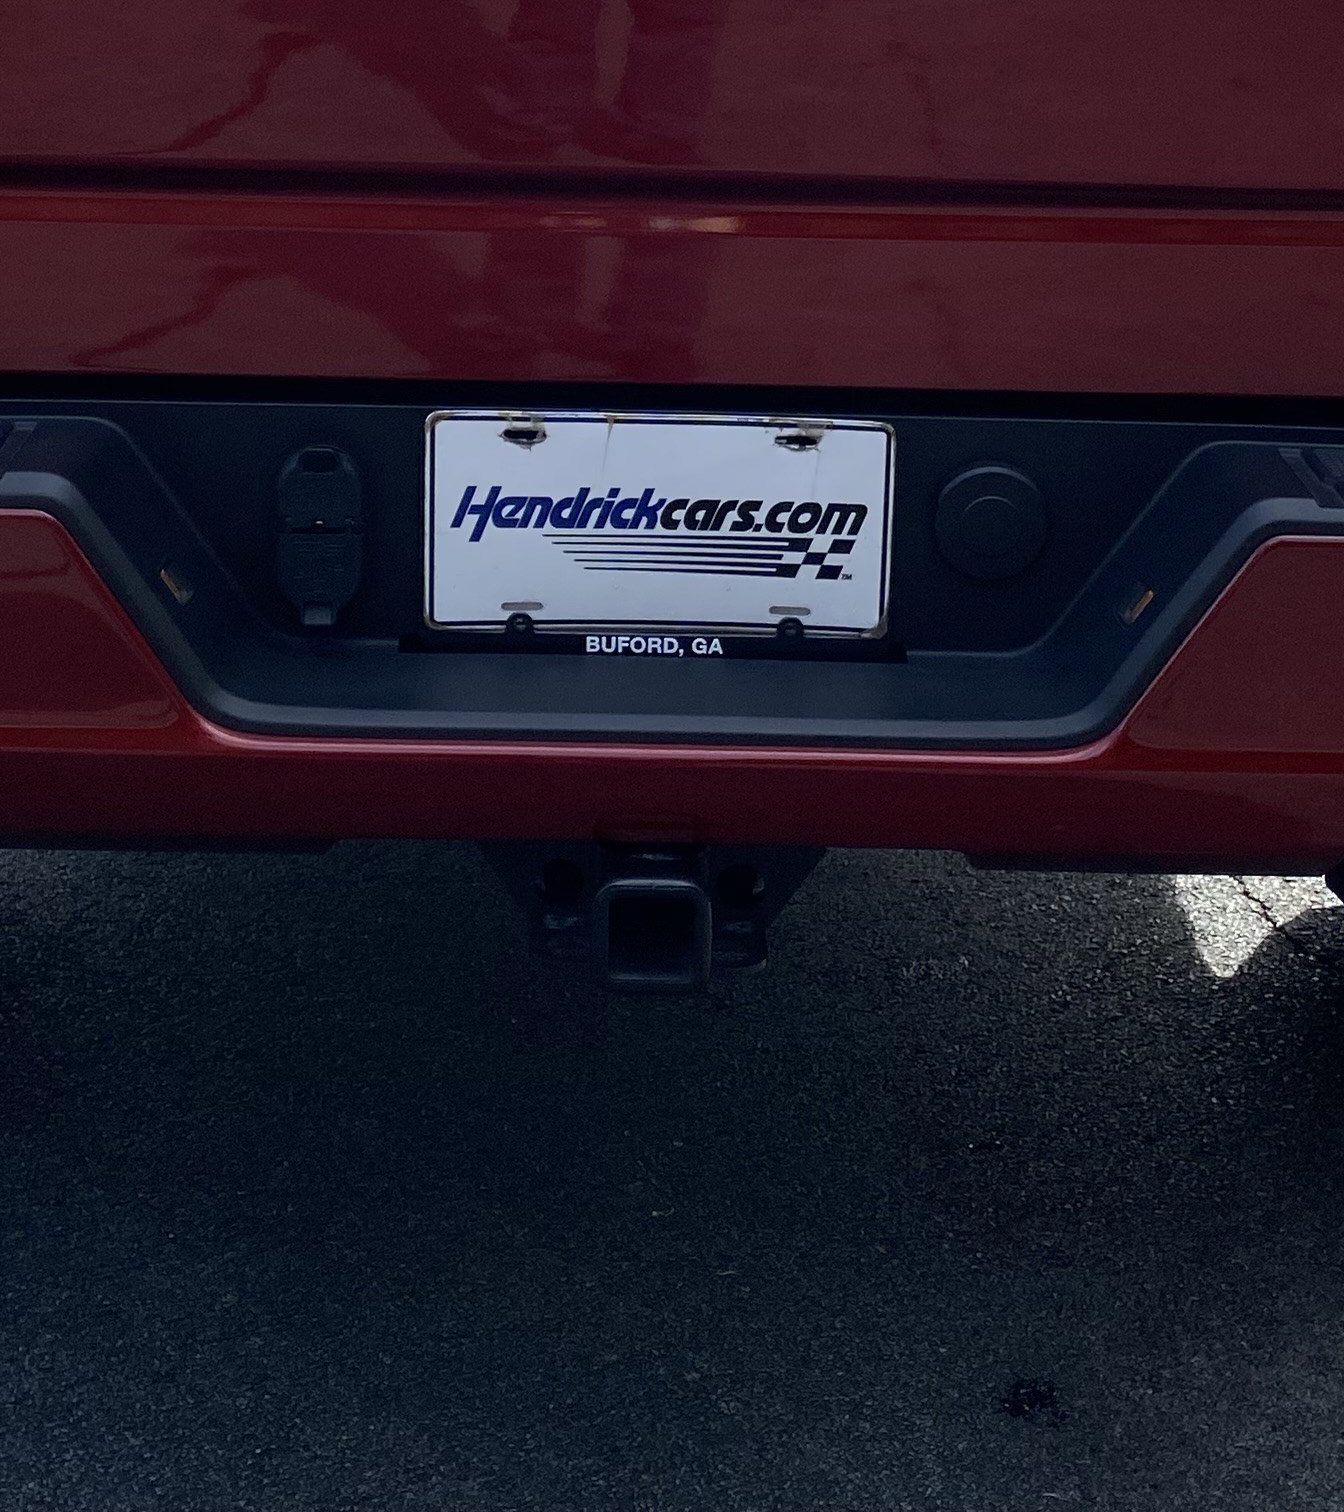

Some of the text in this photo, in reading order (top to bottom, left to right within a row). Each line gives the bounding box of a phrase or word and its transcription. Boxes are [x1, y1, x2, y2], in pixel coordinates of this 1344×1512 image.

[450, 485, 869, 542] Hendrickcars.com
[585, 635, 724, 657] BUFORD, GA
